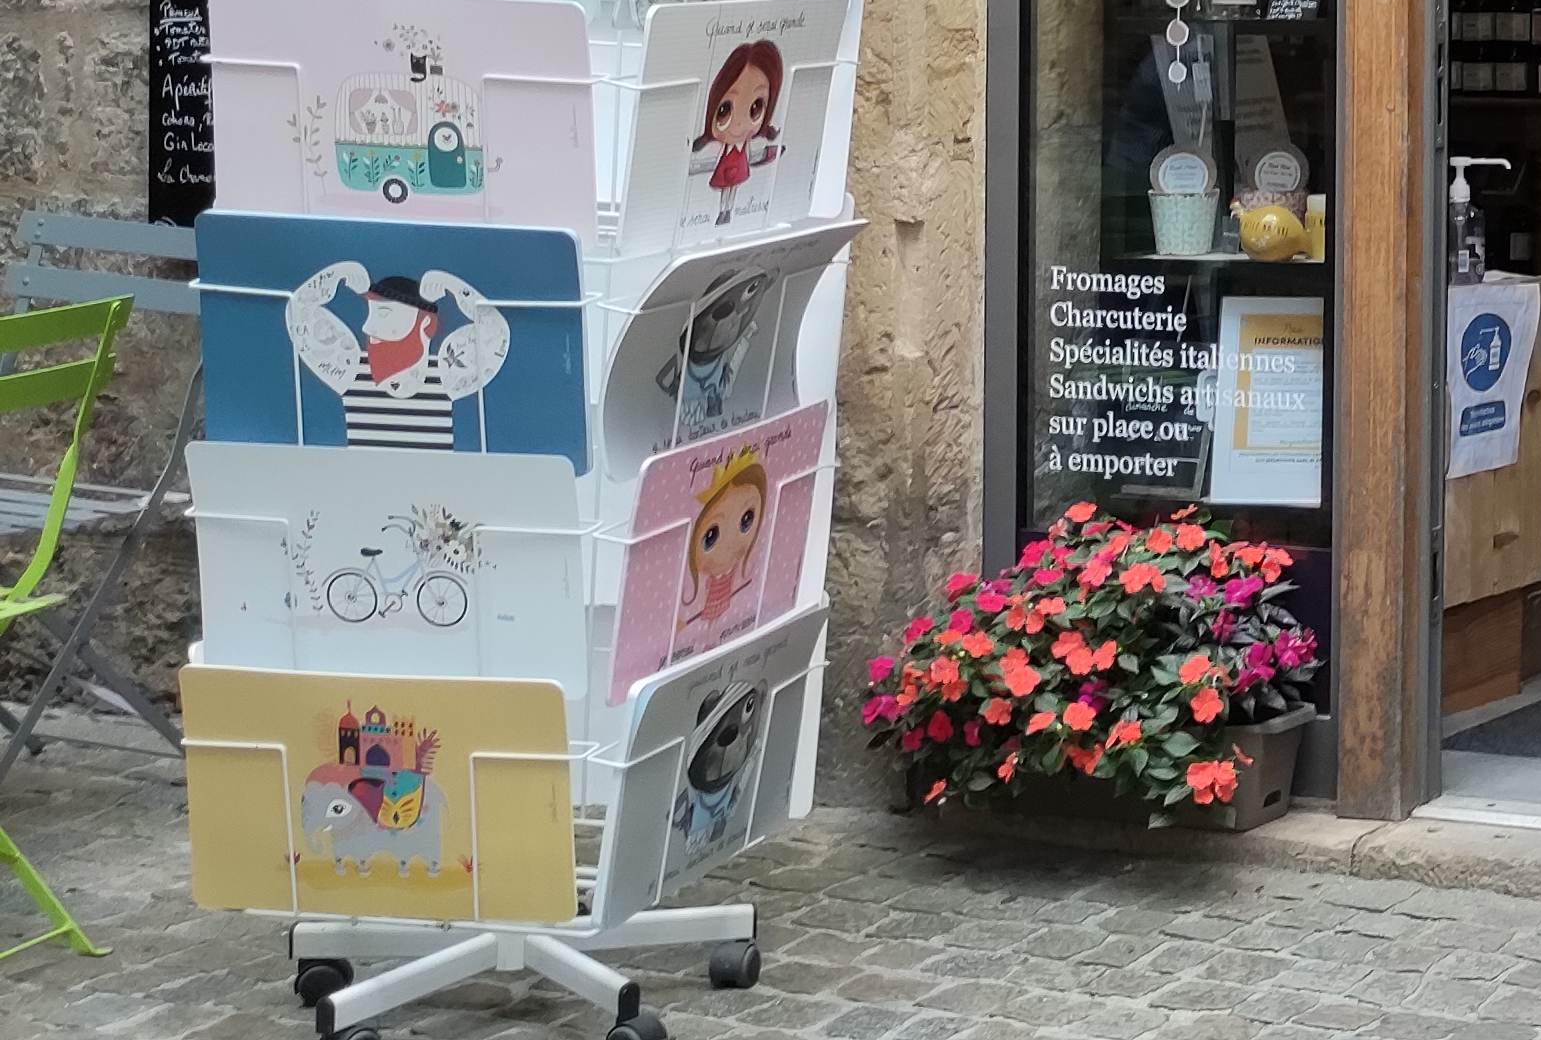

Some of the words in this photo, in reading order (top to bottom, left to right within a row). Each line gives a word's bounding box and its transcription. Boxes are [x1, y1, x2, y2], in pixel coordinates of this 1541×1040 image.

[163, 133, 189, 152] Gin
[1049, 265, 1165, 299] Fromages
[1049, 301, 1187, 332] Charcuterie
[1049, 336, 1174, 368] Spécialités
[1179, 342, 1296, 374] italiennes
[1048, 373, 1174, 404] Sandwichs
[1179, 381, 1306, 410] artisanaux
[1048, 414, 1087, 436] sur
[1092, 411, 1153, 442] place
[1158, 420, 1190, 443] ou
[1048, 444, 1062, 472] à
[1068, 452, 1178, 480] emporter
